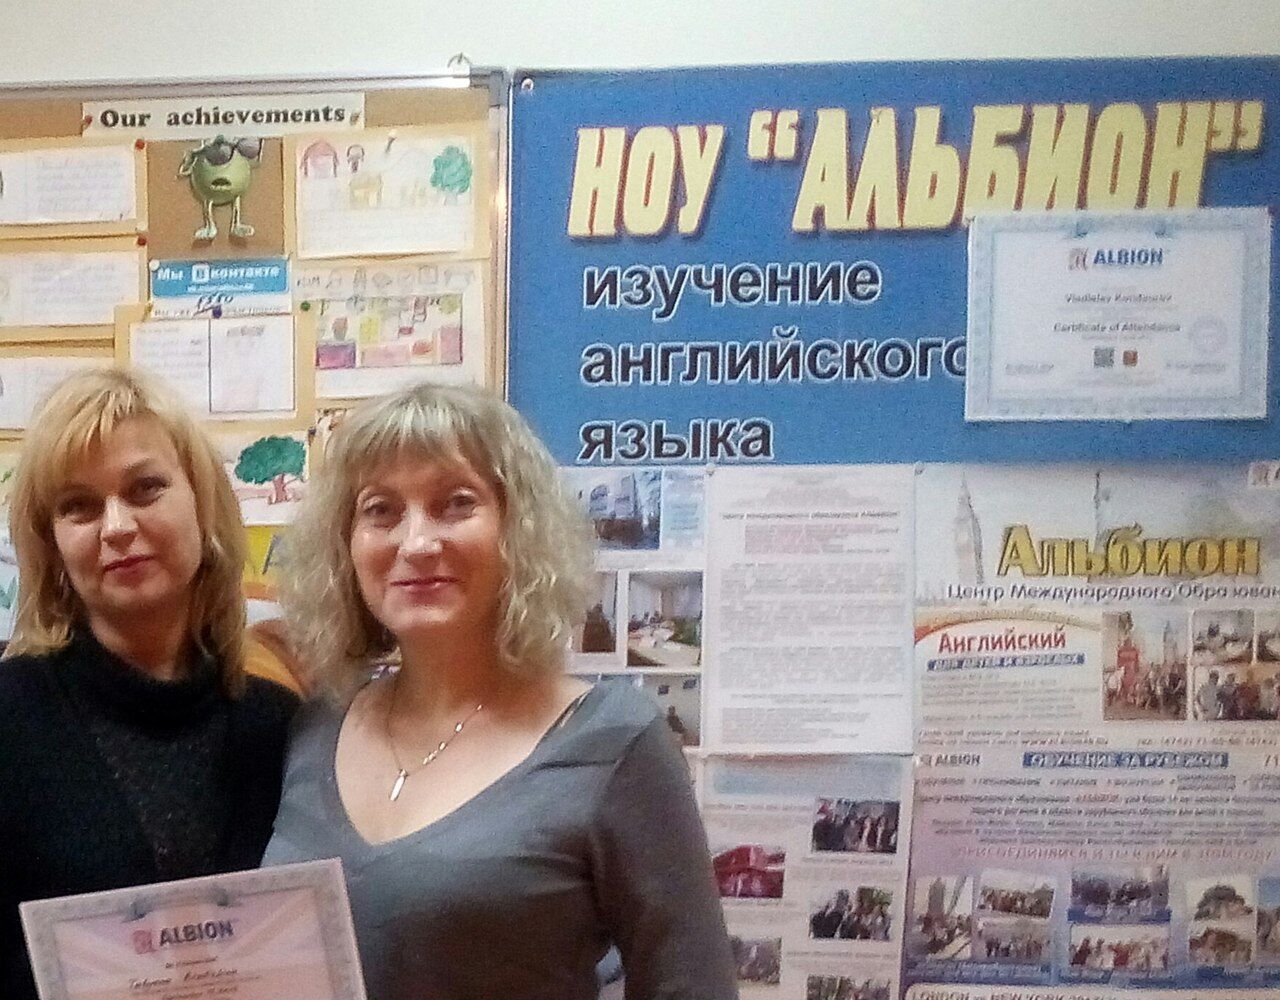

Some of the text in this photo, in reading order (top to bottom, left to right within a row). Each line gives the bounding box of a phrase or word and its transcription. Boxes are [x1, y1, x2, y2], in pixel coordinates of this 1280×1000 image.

[99, 105, 346, 128] Our achievements
[566, 124, 726, 238] НОУ
[1093, 248, 1164, 265] ALBION
[157, 267, 184, 280] Мы
[581, 261, 883, 321] изучение
[578, 416, 775, 463] языка
[997, 522, 1263, 577] Альбион
[948, 584, 1004, 601] Центр
[1011, 583, 1171, 601] Международного
[939, 625, 1066, 653] Английский
[159, 920, 234, 947] ALBION
